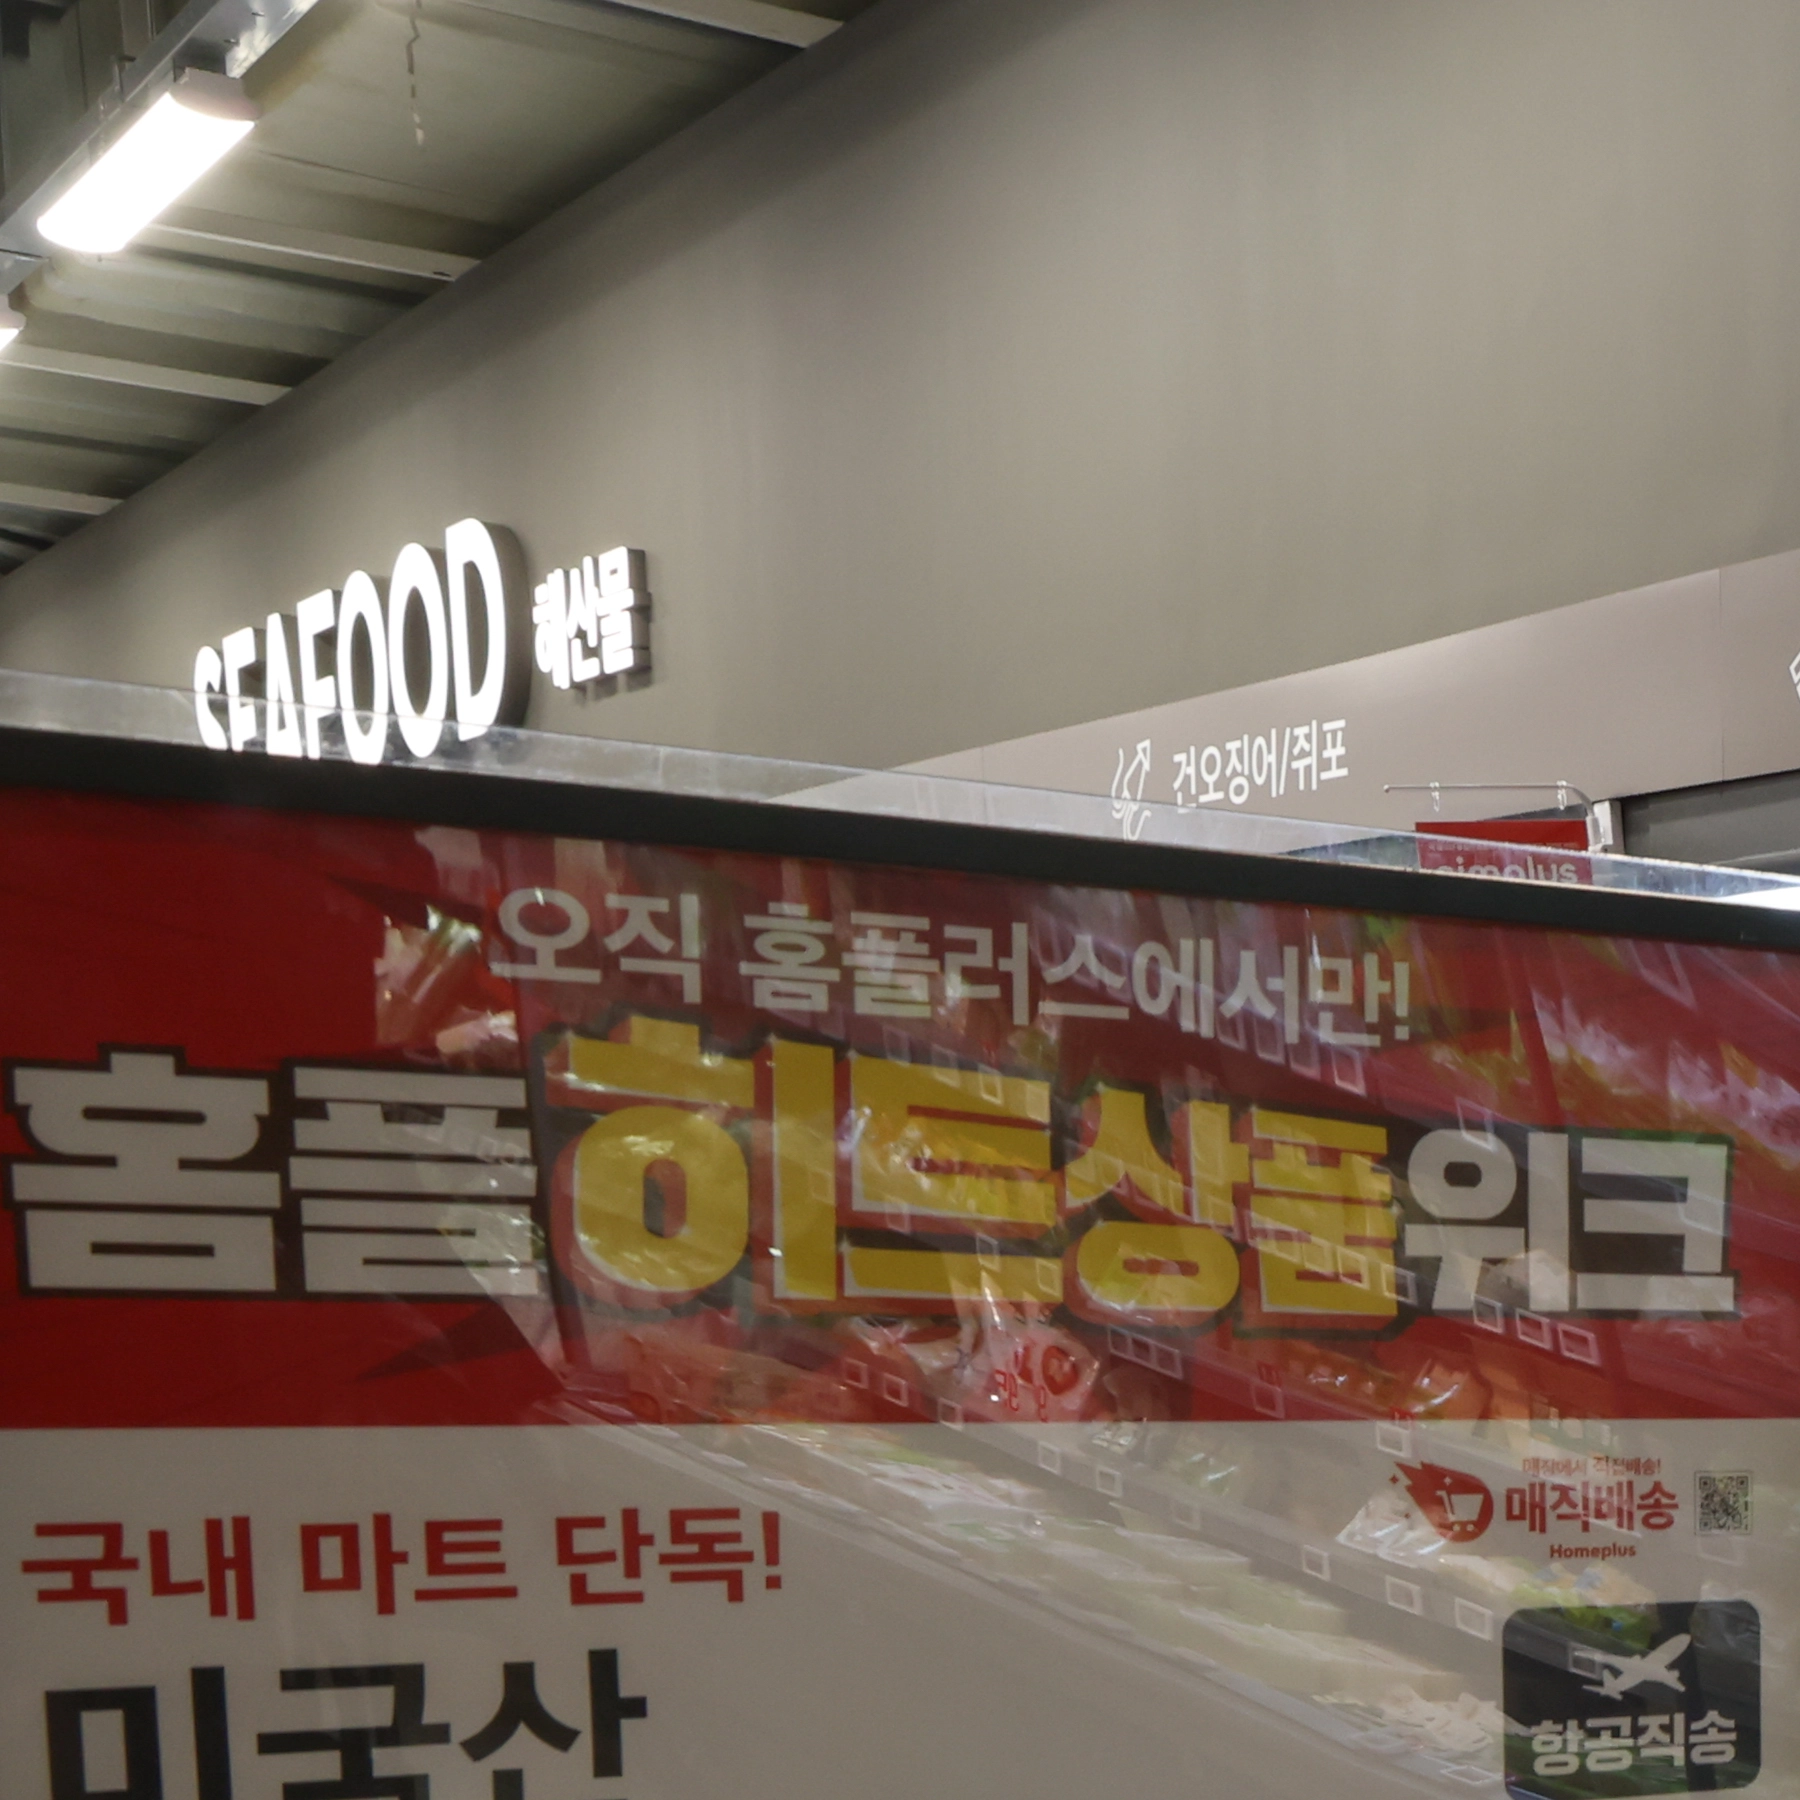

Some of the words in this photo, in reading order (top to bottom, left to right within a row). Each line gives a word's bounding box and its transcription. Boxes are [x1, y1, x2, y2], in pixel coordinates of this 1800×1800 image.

[194, 518, 505, 765] SEAFOOD
[533, 546, 635, 690] 해산물
[1172, 719, 1348, 813] 건오징어/쥐포
[494, 888, 701, 994] 오직
[739, 900, 1411, 1049] 홈플러스에서만!
[1505, 1480, 1679, 1534] 매직배송
[1550, 1543, 1636, 1560] Homeplus
[21, 1515, 256, 1625] 국내
[300, 1512, 519, 1614] 마트
[555, 1506, 781, 1606] 단독!
[1531, 1709, 1738, 1777] 항공직송
